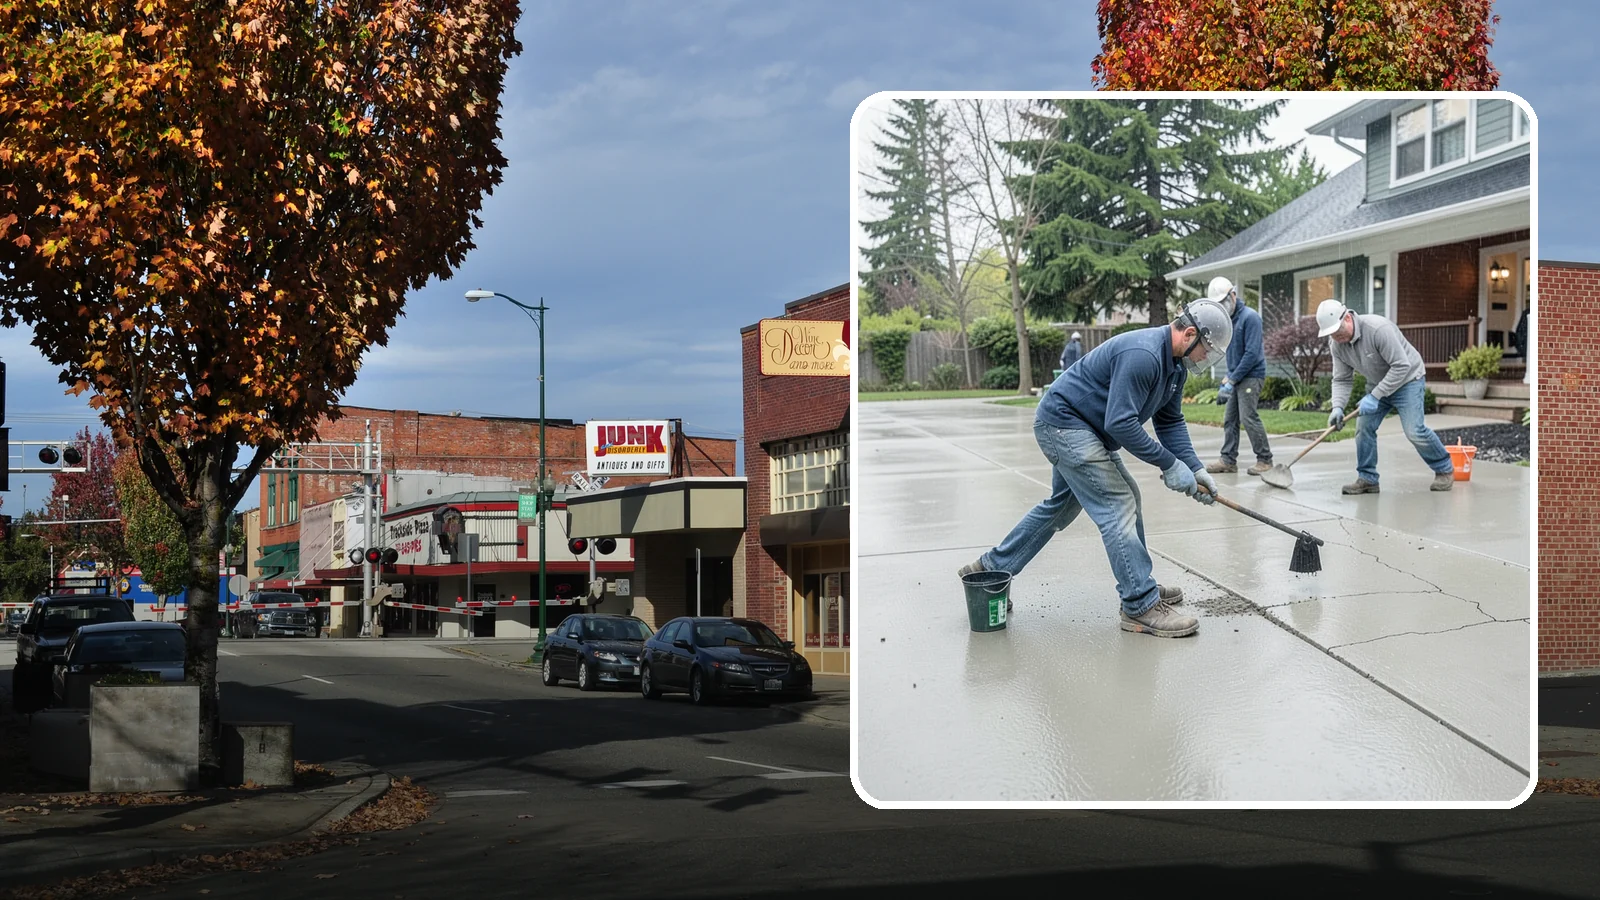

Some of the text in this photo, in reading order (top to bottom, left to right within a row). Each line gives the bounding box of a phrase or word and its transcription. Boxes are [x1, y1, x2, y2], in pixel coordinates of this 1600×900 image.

[596, 425, 665, 457] JUNK
[607, 446, 646, 454] DISORDERLY
[597, 460, 665, 470] ANTIQUES AND GIFTS
[352, 498, 365, 511] CRO
[415, 519, 429, 534] Pizza
